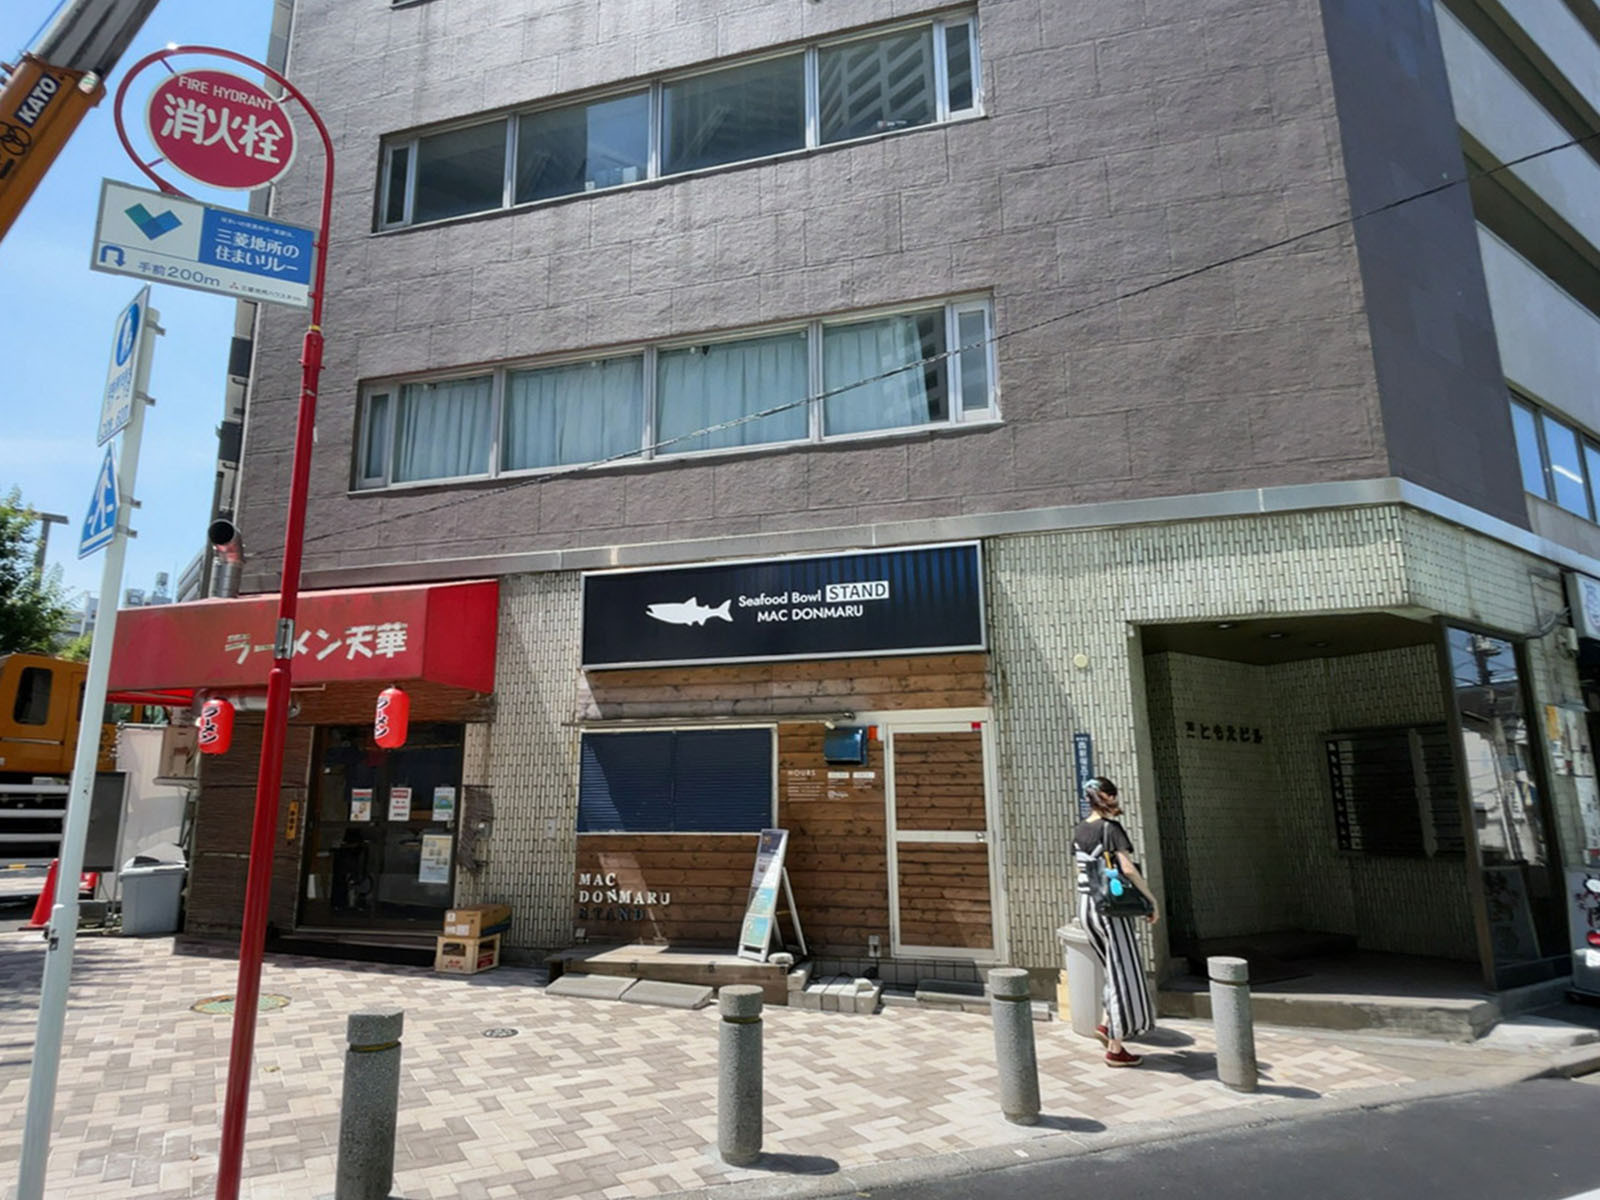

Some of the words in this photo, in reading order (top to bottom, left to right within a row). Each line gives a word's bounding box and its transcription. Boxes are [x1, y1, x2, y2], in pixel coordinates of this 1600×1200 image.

[18, 77, 57, 124] KATO
[178, 76, 209, 95] FIRE
[213, 84, 273, 112] HYDRANT
[160, 93, 285, 164] 消火栓
[215, 228, 299, 259] 三菱地所の
[215, 245, 299, 272] 住まいリレー
[138, 261, 221, 287] 手前200m
[738, 591, 788, 608] Seafood
[791, 589, 822, 604] Bowl
[828, 582, 887, 601] STAND
[757, 609, 788, 623] MAC
[791, 604, 864, 621] DONMARU
[224, 621, 409, 665] ラーメン天華
[200, 705, 220, 744] ラーメン
[578, 872, 617, 887] MAC
[578, 888, 671, 906] DONMARU
